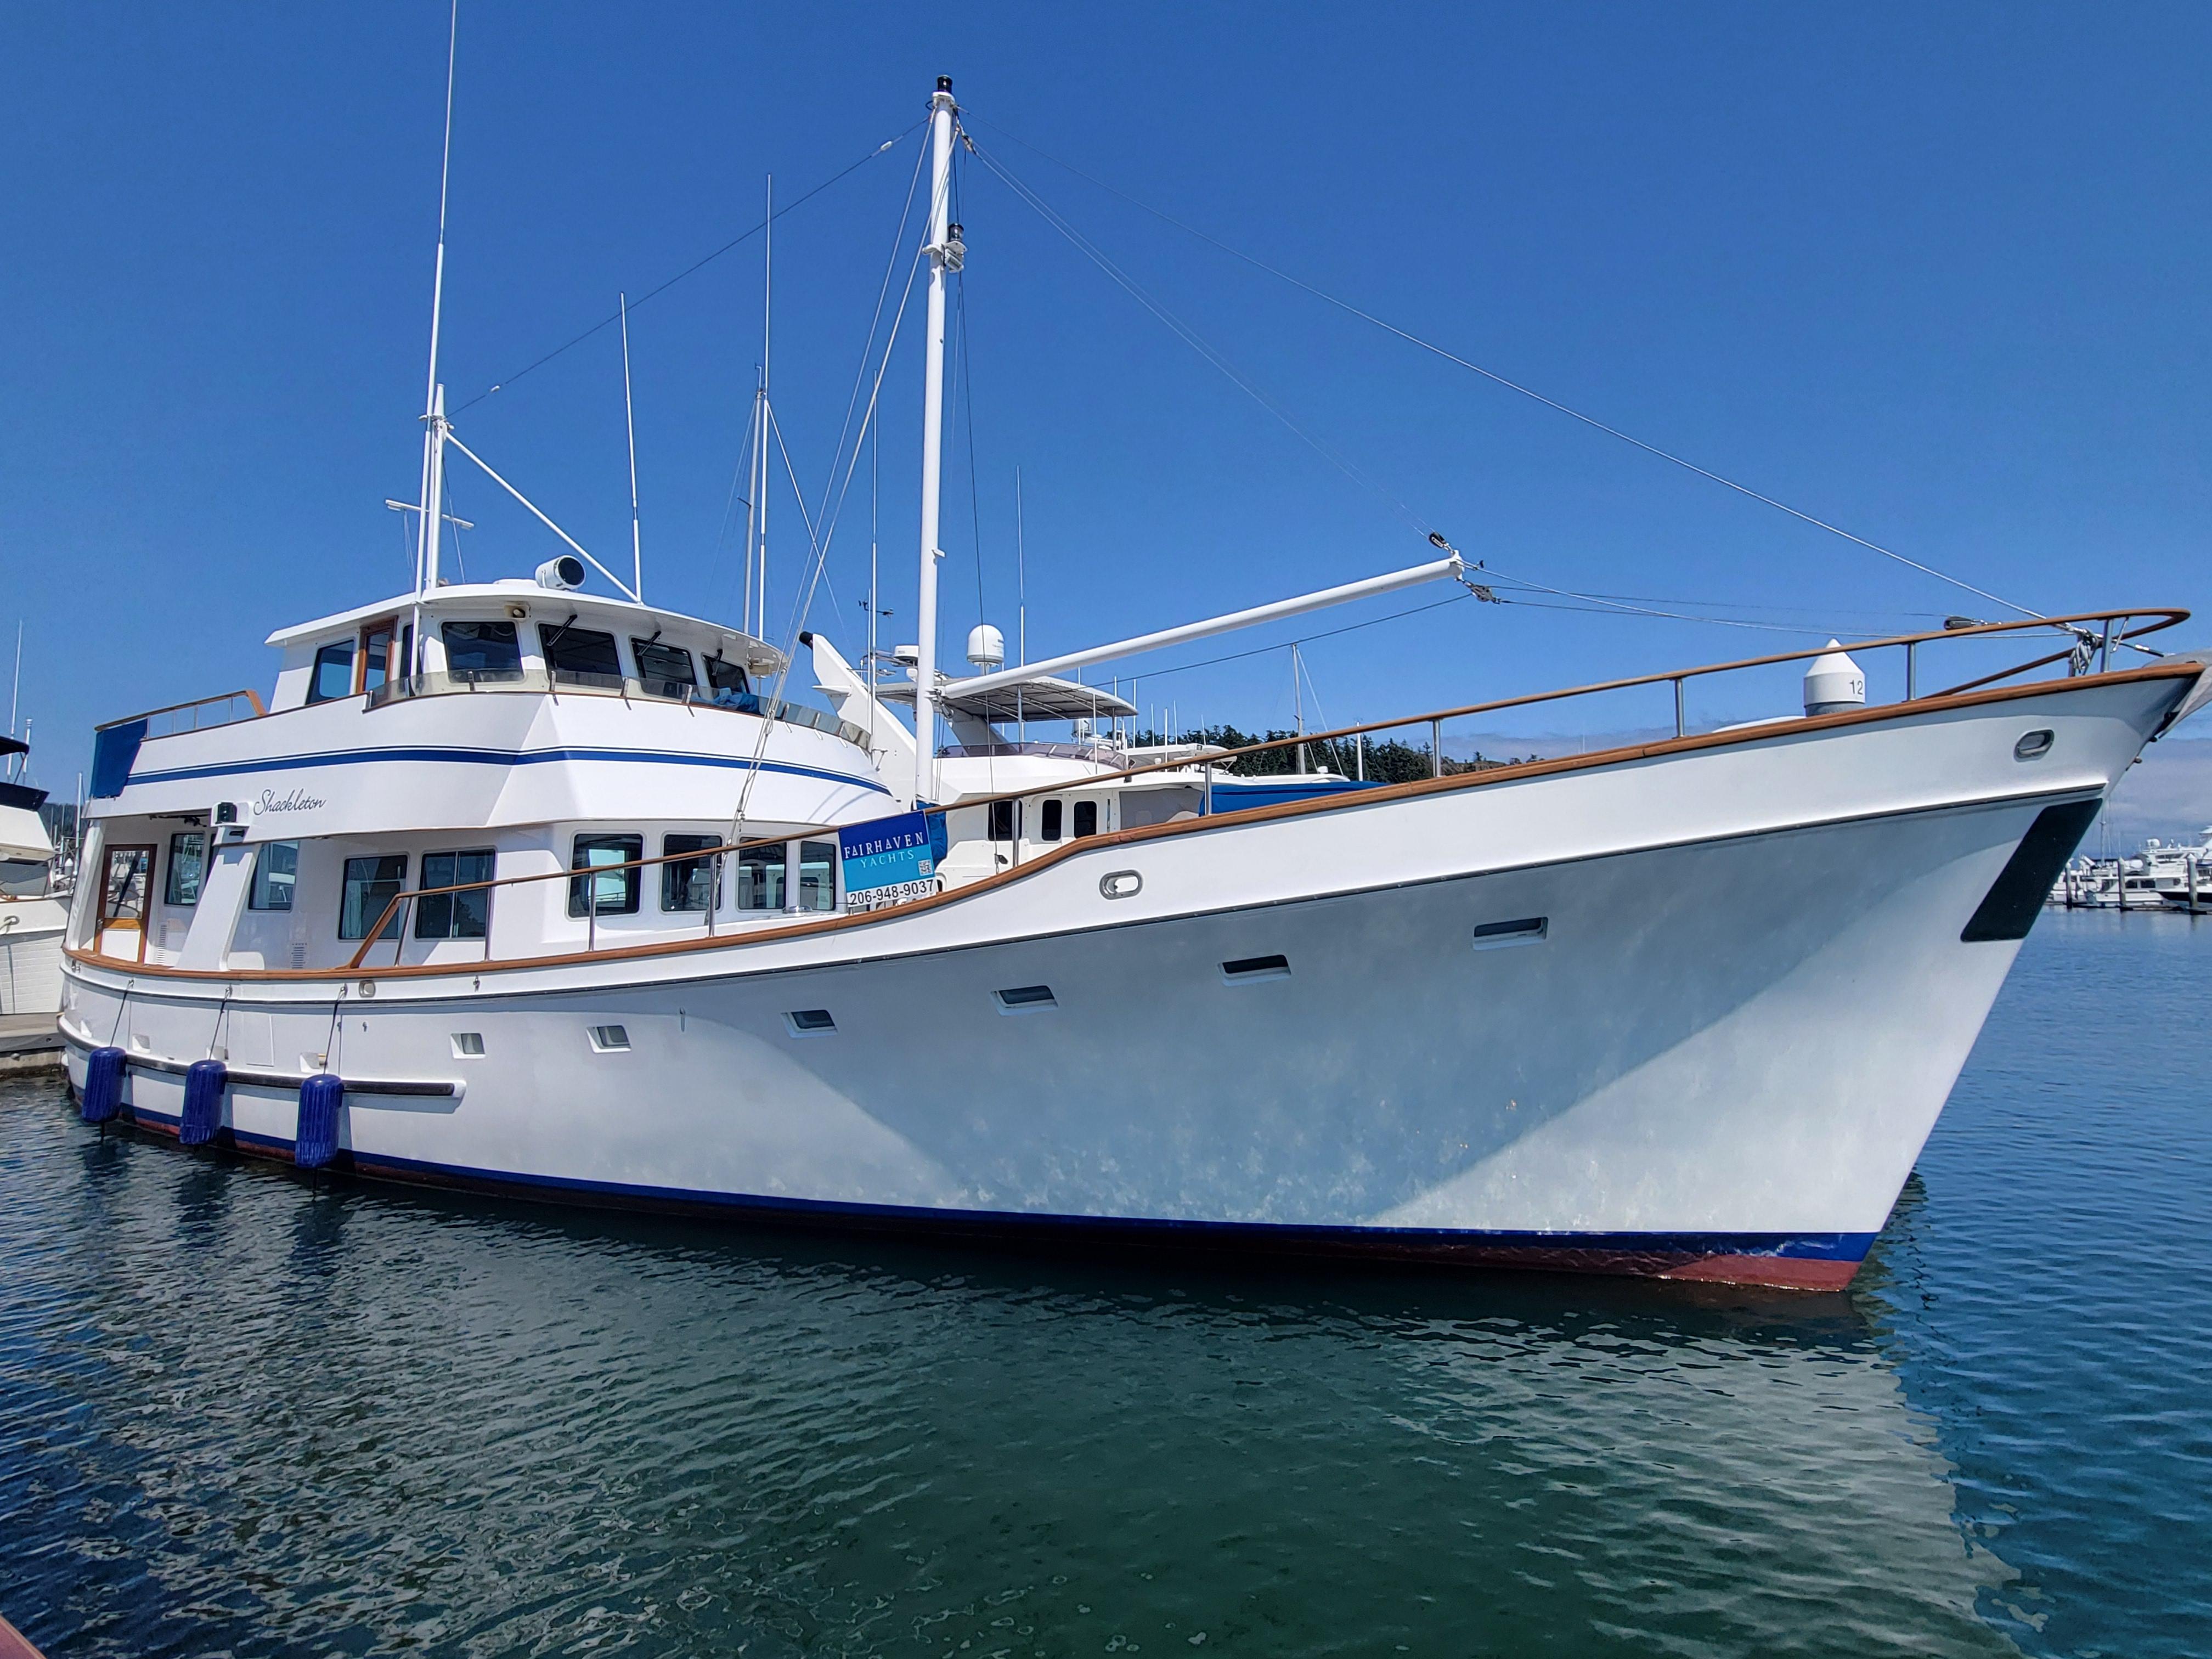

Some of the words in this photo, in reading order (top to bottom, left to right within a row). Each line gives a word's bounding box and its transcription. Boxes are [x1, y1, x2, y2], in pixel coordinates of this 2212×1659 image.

[1849, 680, 1863, 695] 12
[253, 788, 328, 816] Shackleton
[844, 832, 923, 859] FAIRHAVEN
[860, 850, 915, 868] YACHTS
[850, 879, 934, 905] 206-948-9037
